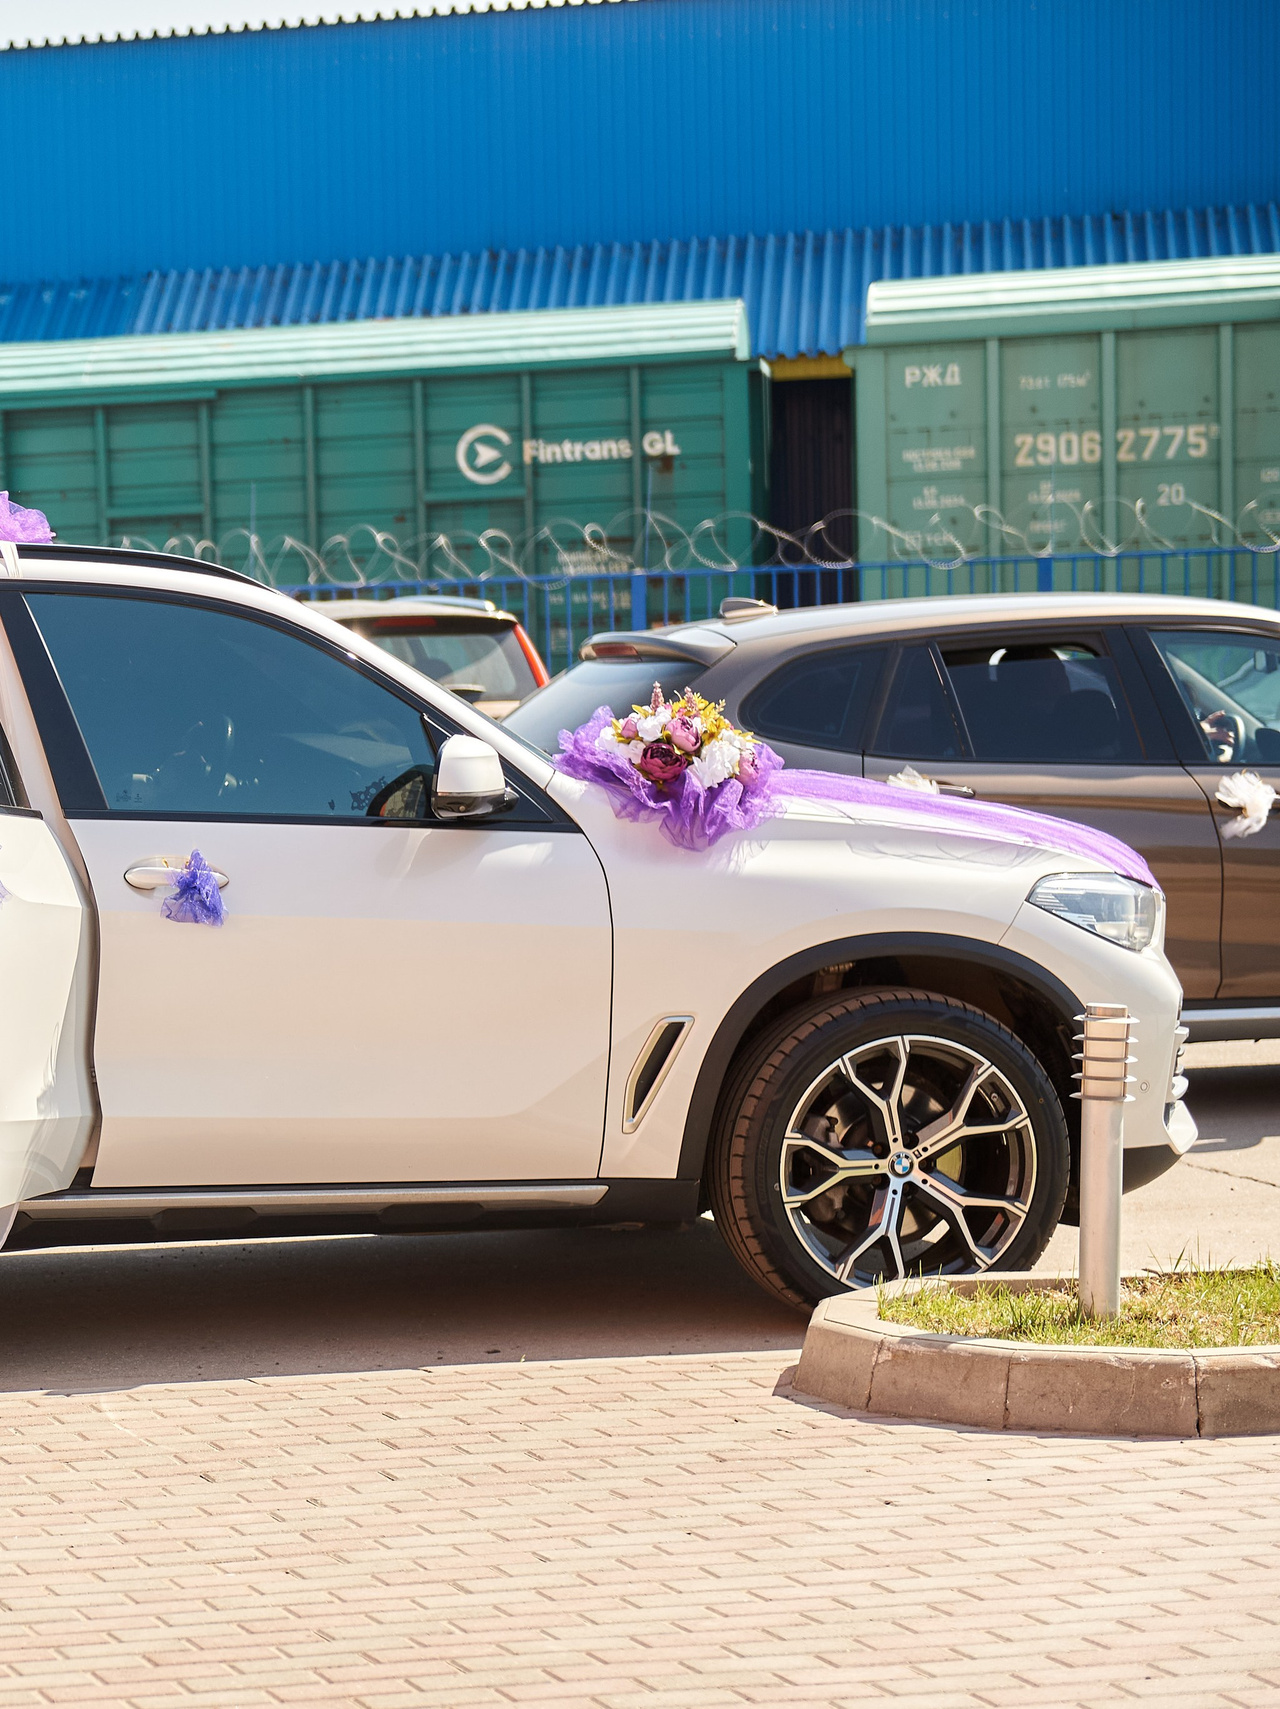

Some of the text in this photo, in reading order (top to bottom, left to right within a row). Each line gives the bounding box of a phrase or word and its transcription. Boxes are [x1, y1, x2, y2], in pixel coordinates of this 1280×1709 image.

[904, 362, 962, 388] РЖД
[523, 430, 681, 465] Fintrans GL
[1014, 430, 1102, 467] 2906
[1116, 424, 1208, 462] 2775
[1157, 482, 1185, 507] 20
